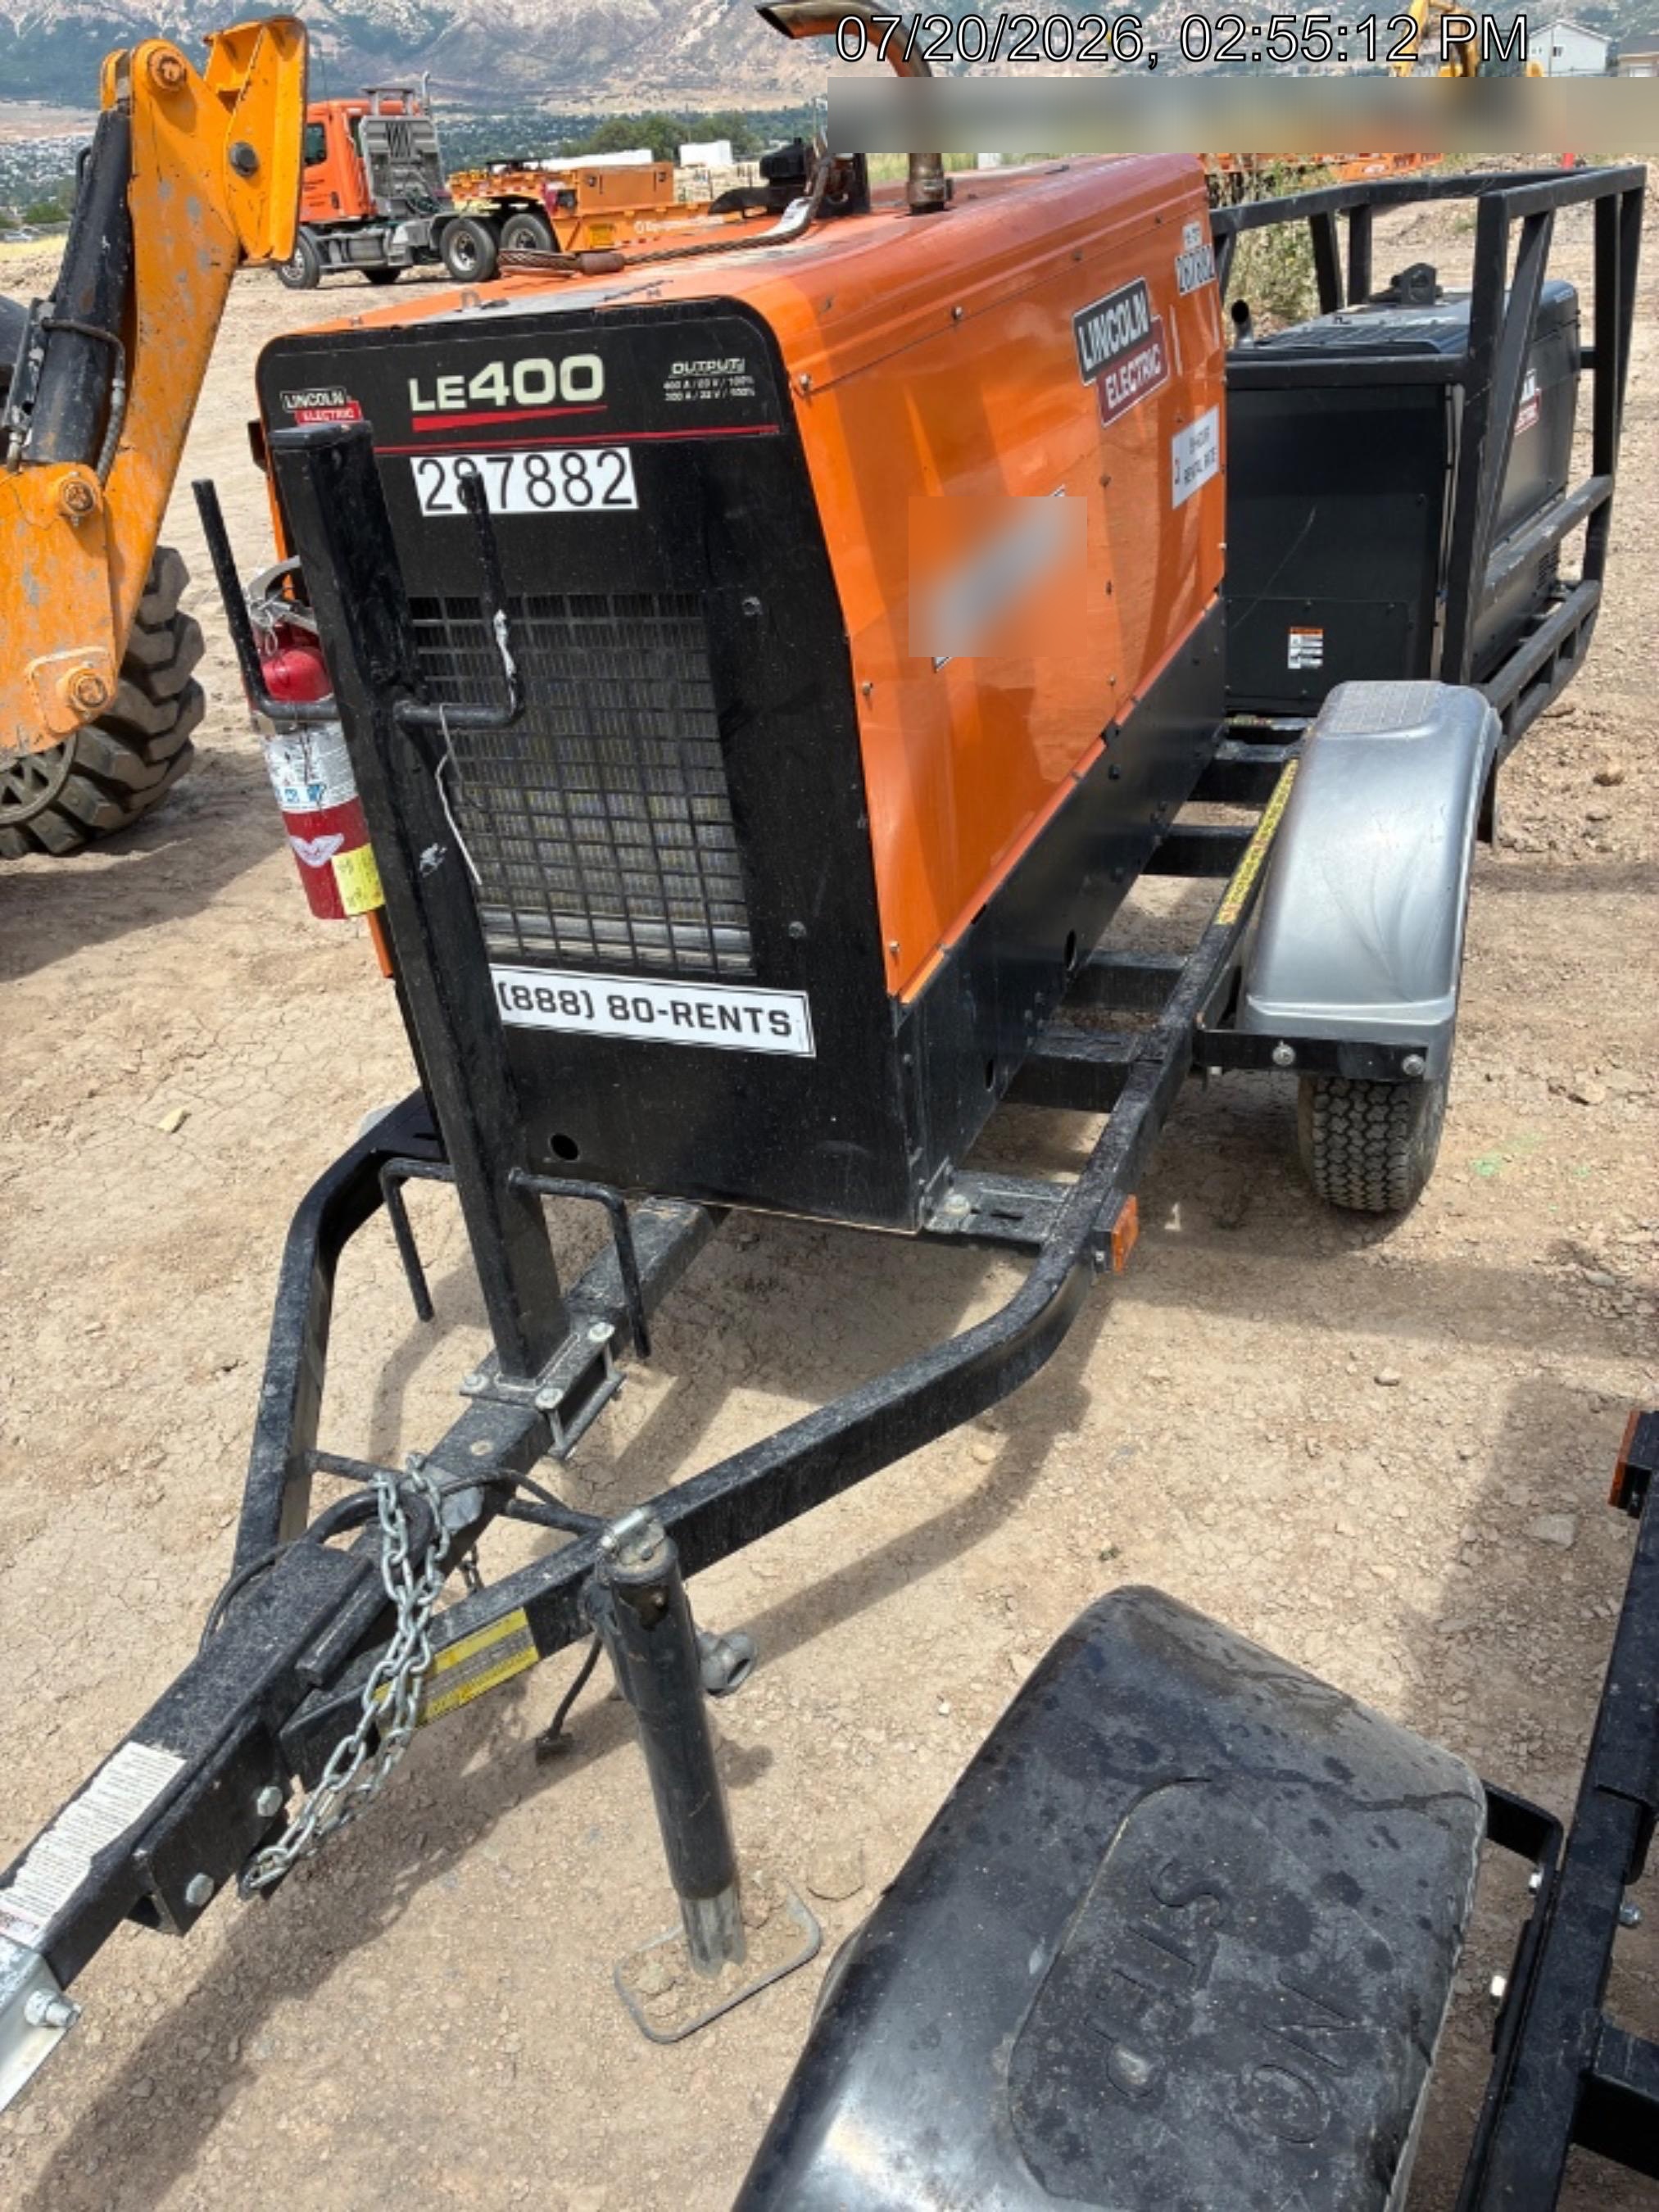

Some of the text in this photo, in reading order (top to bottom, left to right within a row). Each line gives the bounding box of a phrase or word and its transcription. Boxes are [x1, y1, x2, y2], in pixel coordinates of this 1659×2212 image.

[1078, 291, 1149, 372] LINCOLN
[283, 391, 345, 409] LINCOLN
[408, 353, 605, 410] LE400
[1105, 343, 1162, 409] ELECTRIC
[497, 981, 792, 1038] (888) 80-RENTS
[1081, 1862, 1231, 2099] STEP
[1249, 1974, 1367, 2145] NO
